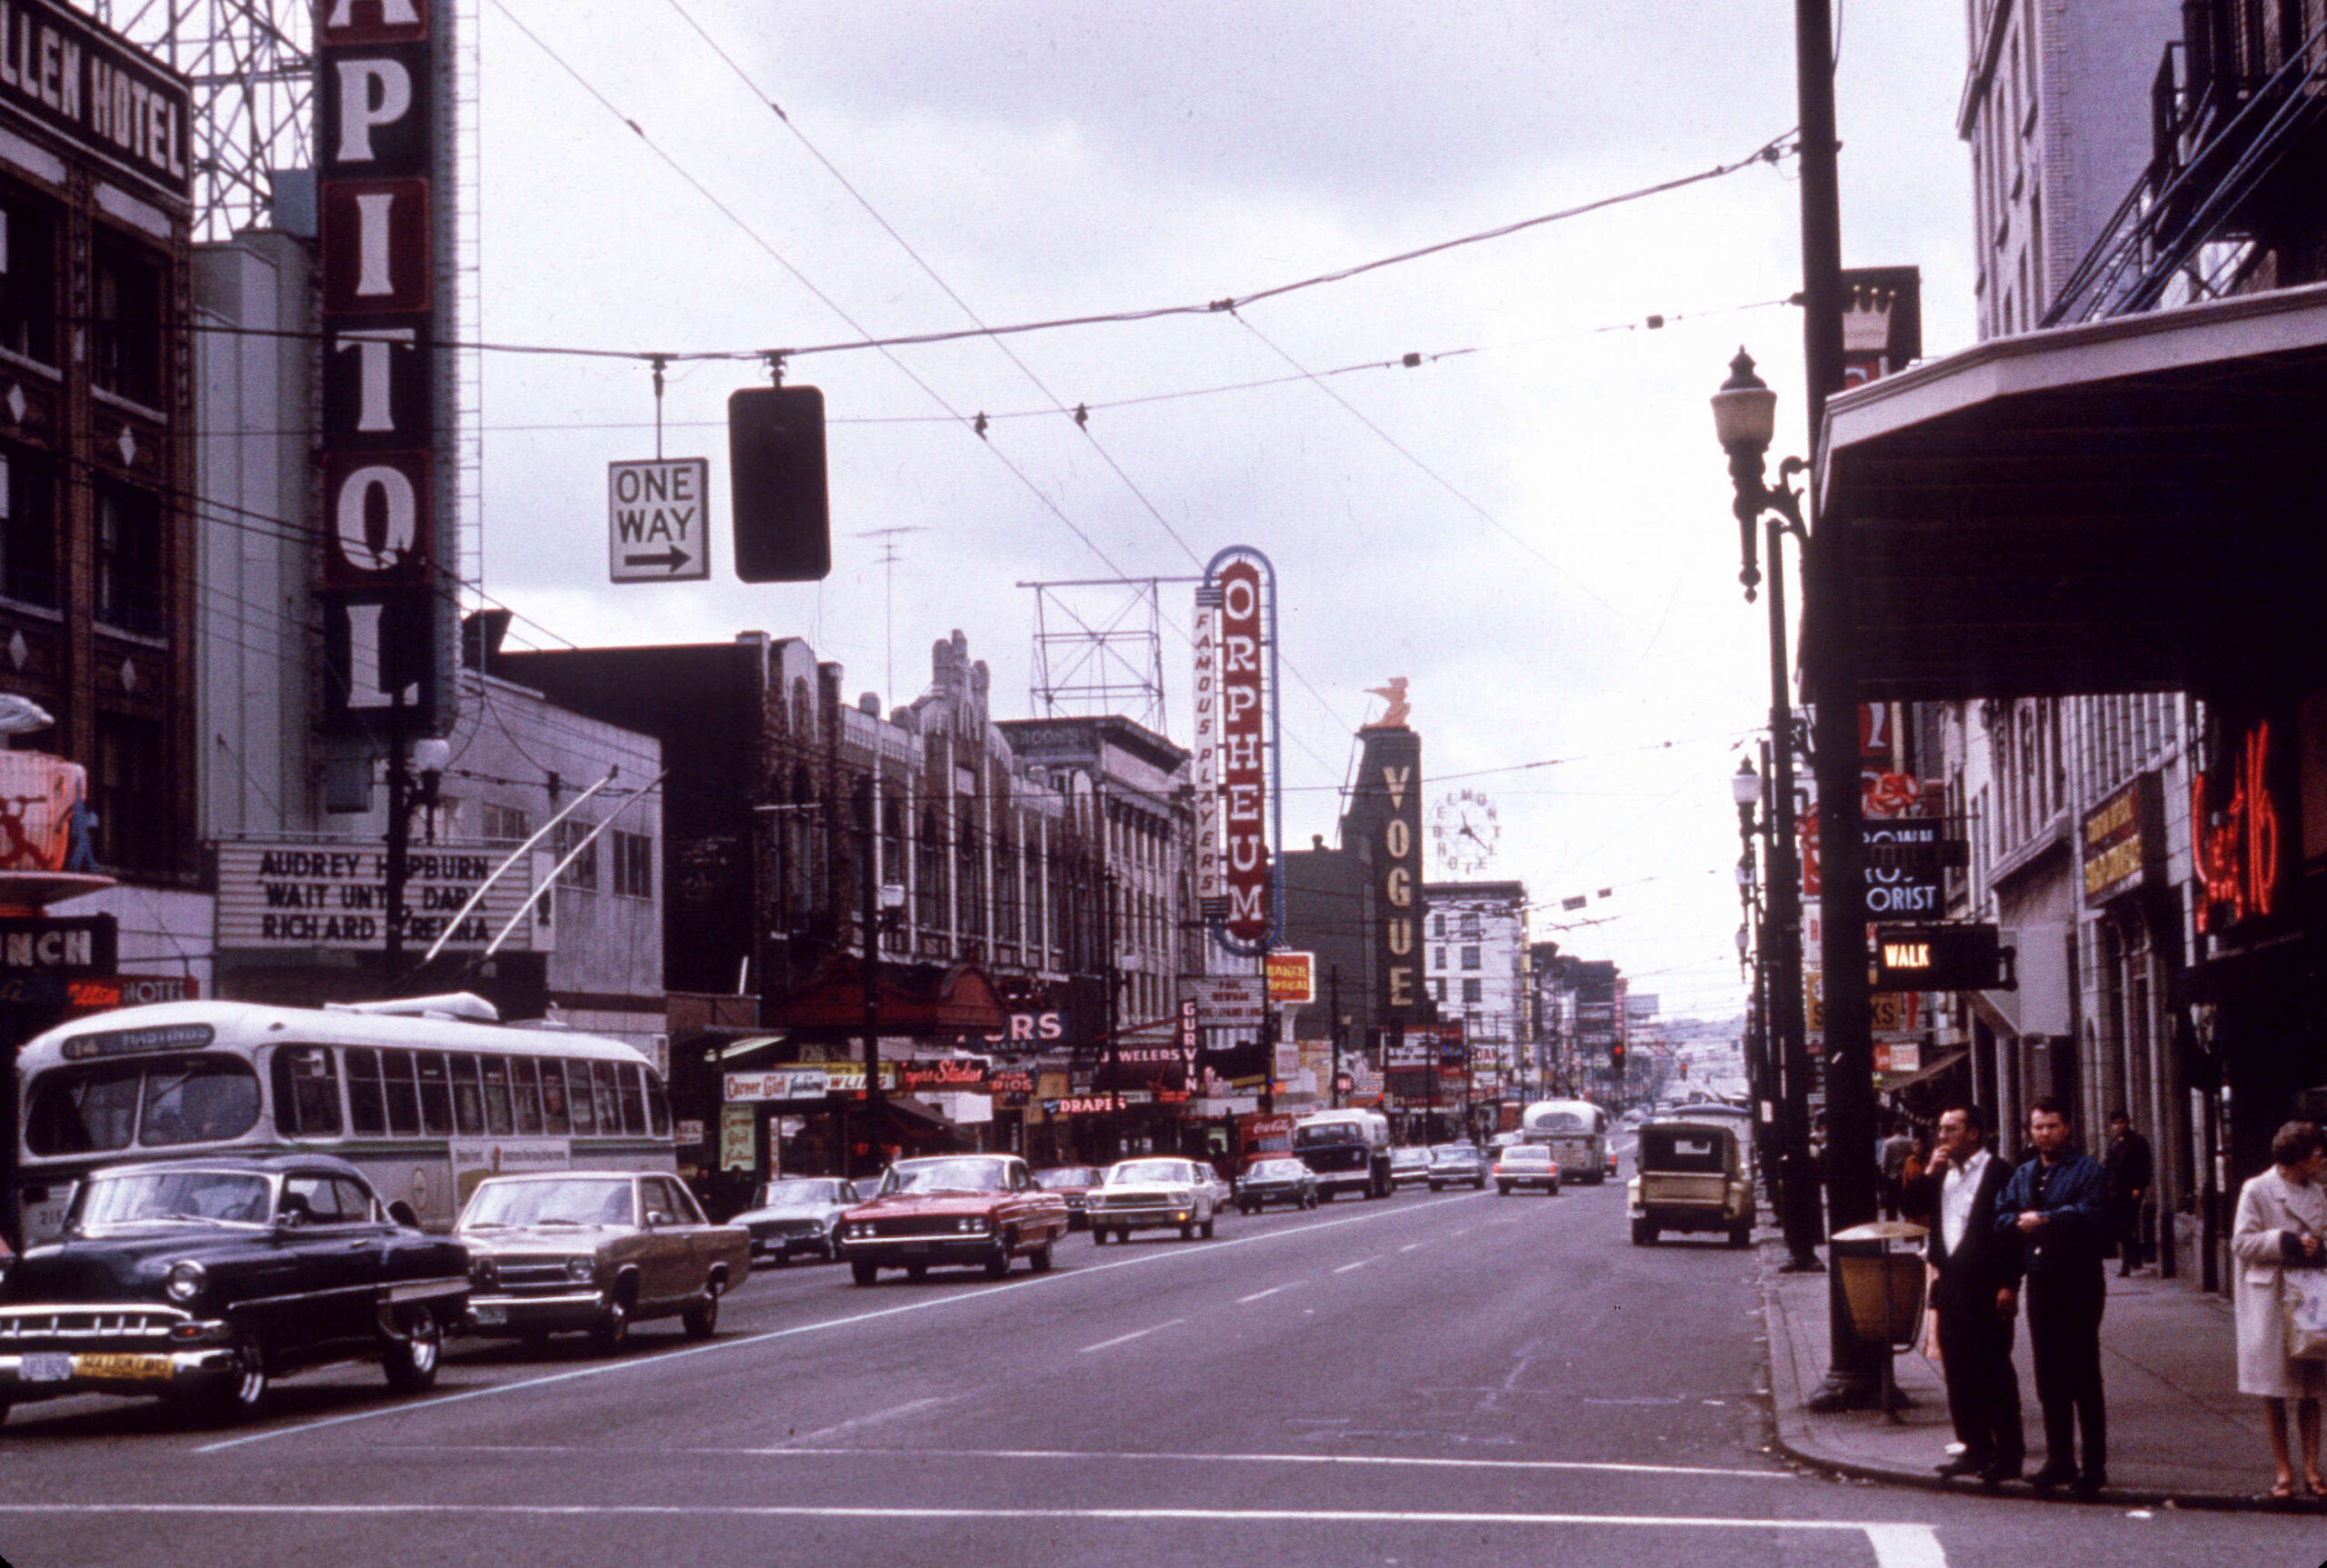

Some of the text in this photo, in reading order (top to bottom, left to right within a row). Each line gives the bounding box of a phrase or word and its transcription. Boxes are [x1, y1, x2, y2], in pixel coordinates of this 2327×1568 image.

[93, 55, 185, 180] HOTEL
[328, 0, 419, 708] PITOL
[617, 466, 694, 504] ONE
[617, 506, 695, 544] WAY
[1195, 614, 1213, 734] FAMOUS
[1225, 578, 1263, 922] ORPHEUM
[1198, 748, 1214, 891] PLAYERS
[258, 851, 488, 880] AUDREY HPBURN
[266, 884, 328, 908] WAIT
[1383, 766, 1413, 1005] VOGUE
[1867, 885, 1936, 911] ORIST
[263, 914, 376, 940] RICHARD
[1884, 944, 1930, 968] WALK
[1100, 1049, 1181, 1064] JWELERS
[764, 1075, 786, 1097] Girl
